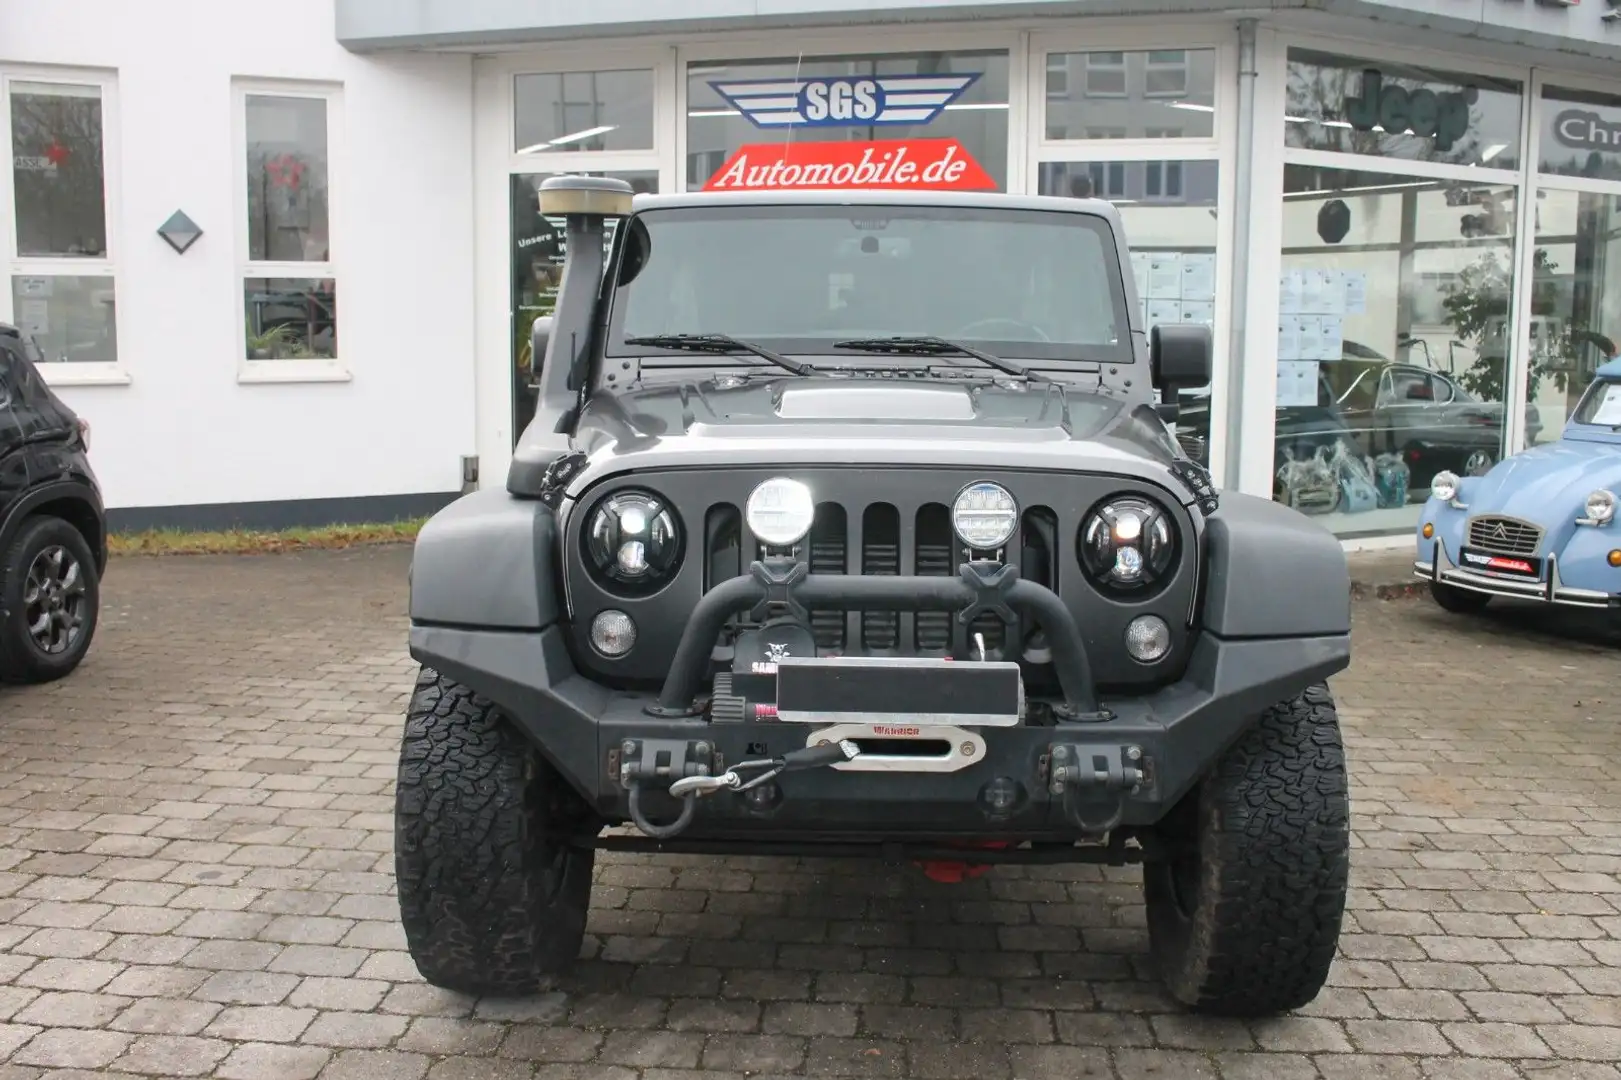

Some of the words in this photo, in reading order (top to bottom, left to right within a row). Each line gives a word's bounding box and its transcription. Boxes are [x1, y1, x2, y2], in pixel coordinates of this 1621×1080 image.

[805, 80, 877, 121] SGS
[714, 145, 968, 187] Automobile.de
[517, 232, 553, 249] Unsere
